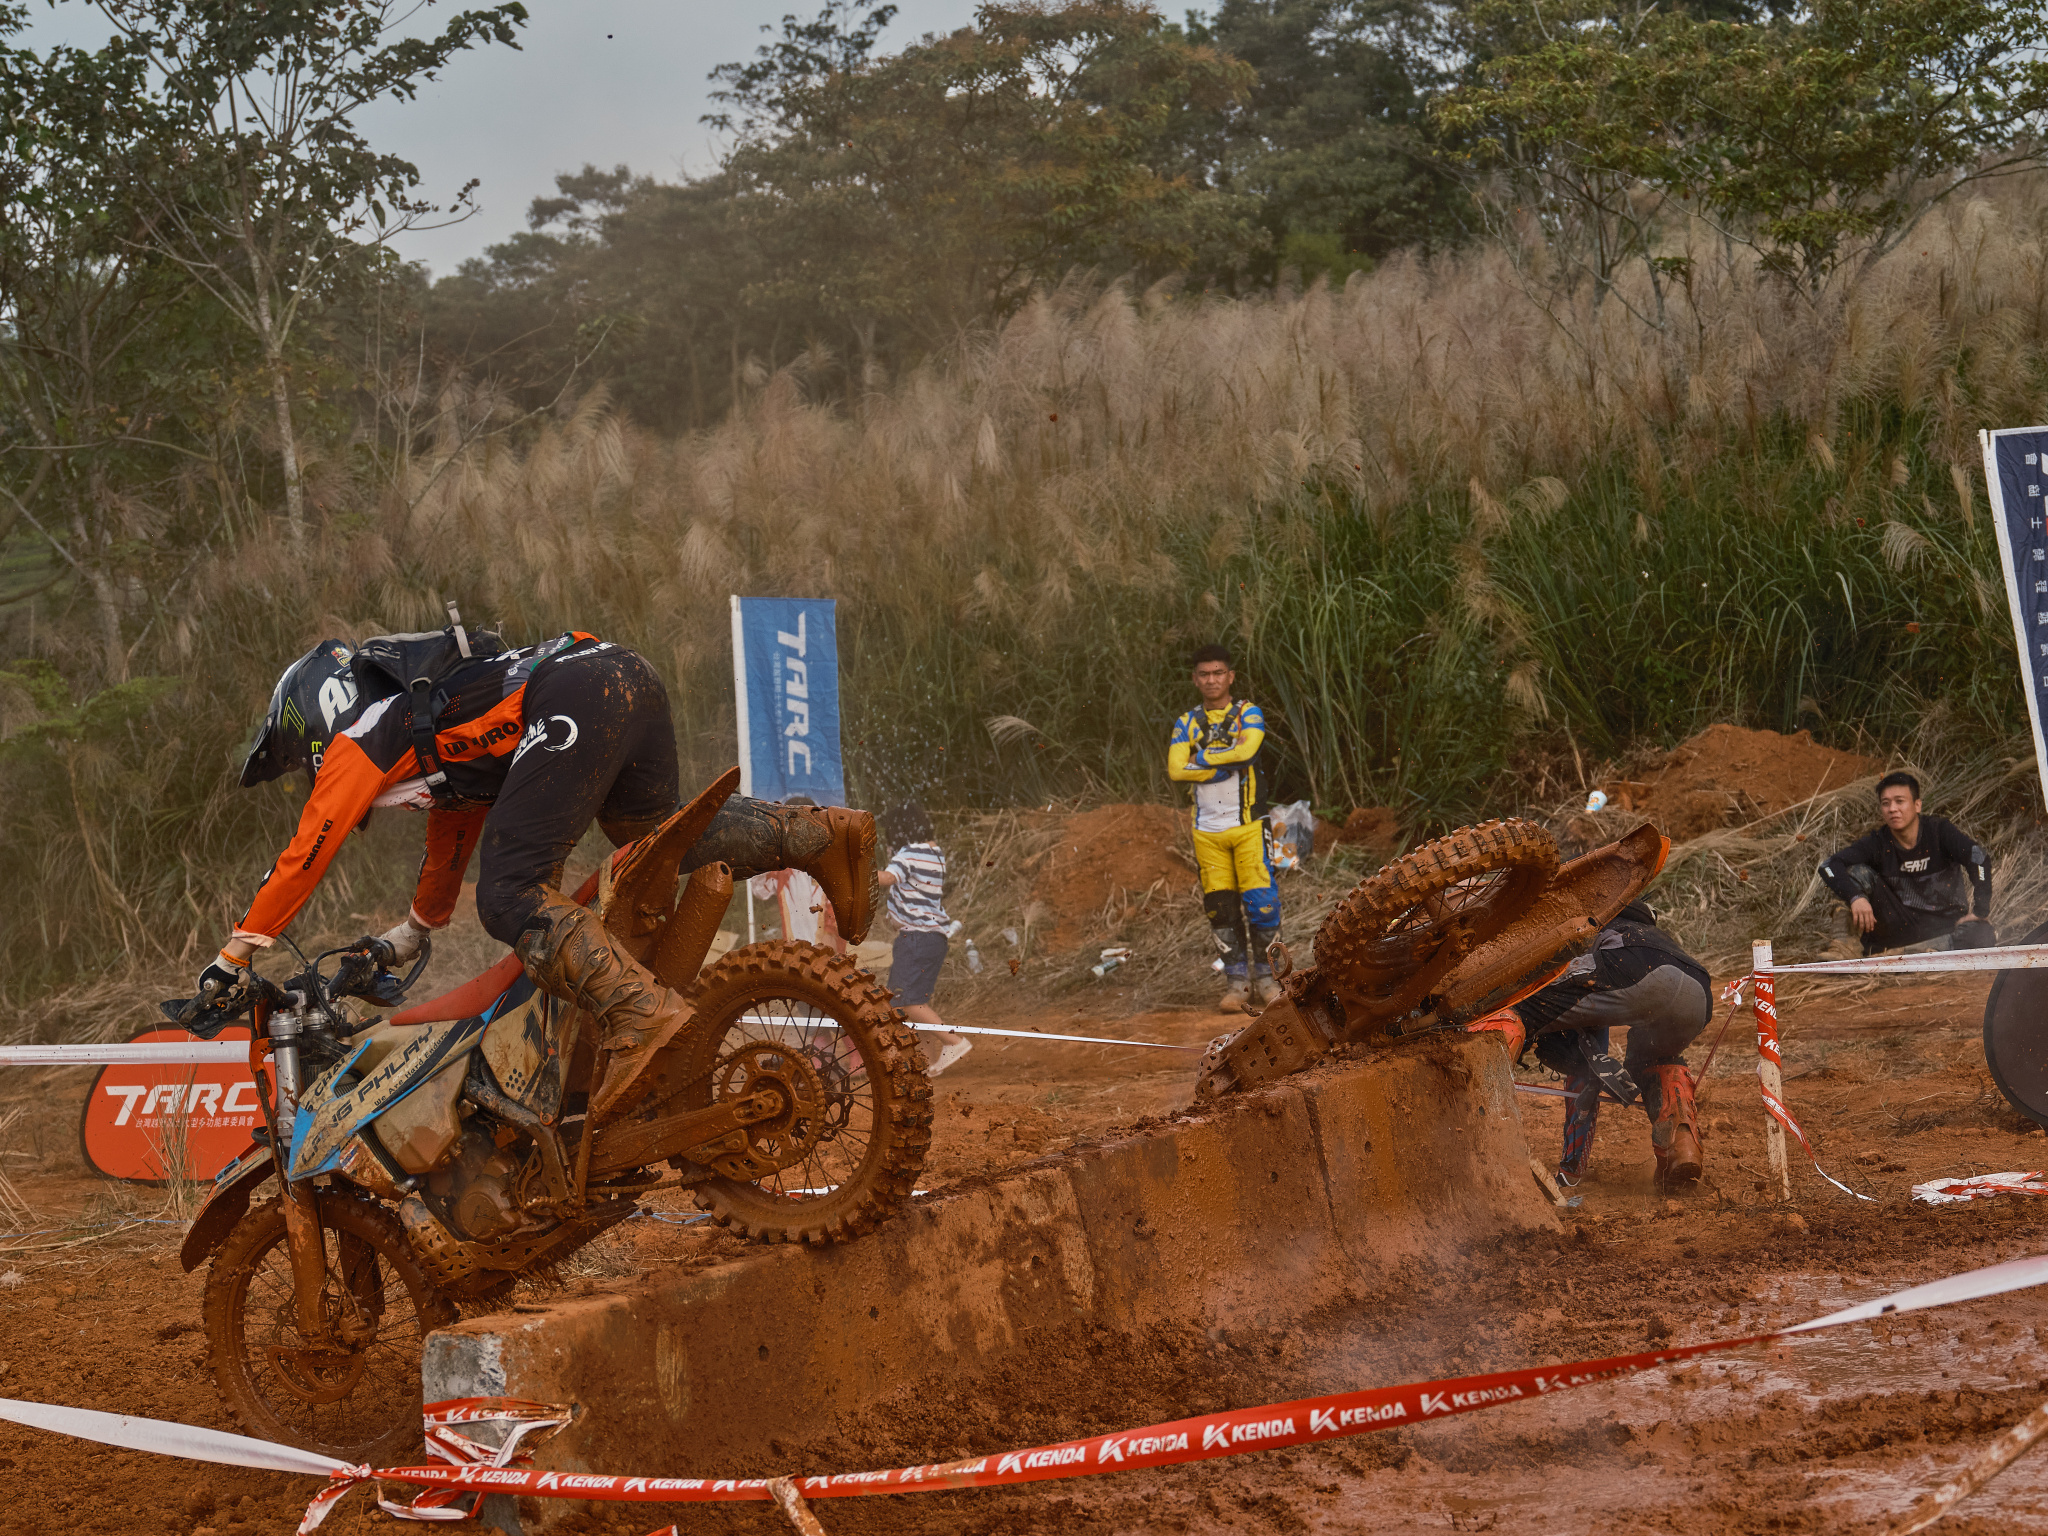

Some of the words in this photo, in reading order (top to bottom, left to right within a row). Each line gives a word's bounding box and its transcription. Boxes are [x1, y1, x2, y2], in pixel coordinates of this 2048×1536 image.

[777, 611, 811, 775] TARC
[357, 1025, 433, 1103] PHLAY
[388, 1079, 405, 1095] Are
[405, 1058, 424, 1080] Hard
[105, 1081, 258, 1127] TARC
[1025, 1446, 1086, 1468] KENDA
[1127, 1432, 1188, 1457] KENDA
[1232, 1418, 1296, 1443] KENDA
[1340, 1402, 1407, 1427] KENDA
[476, 1470, 531, 1486] KENDA
[561, 1474, 618, 1489] KENDA
[649, 1478, 706, 1490] KENDA
